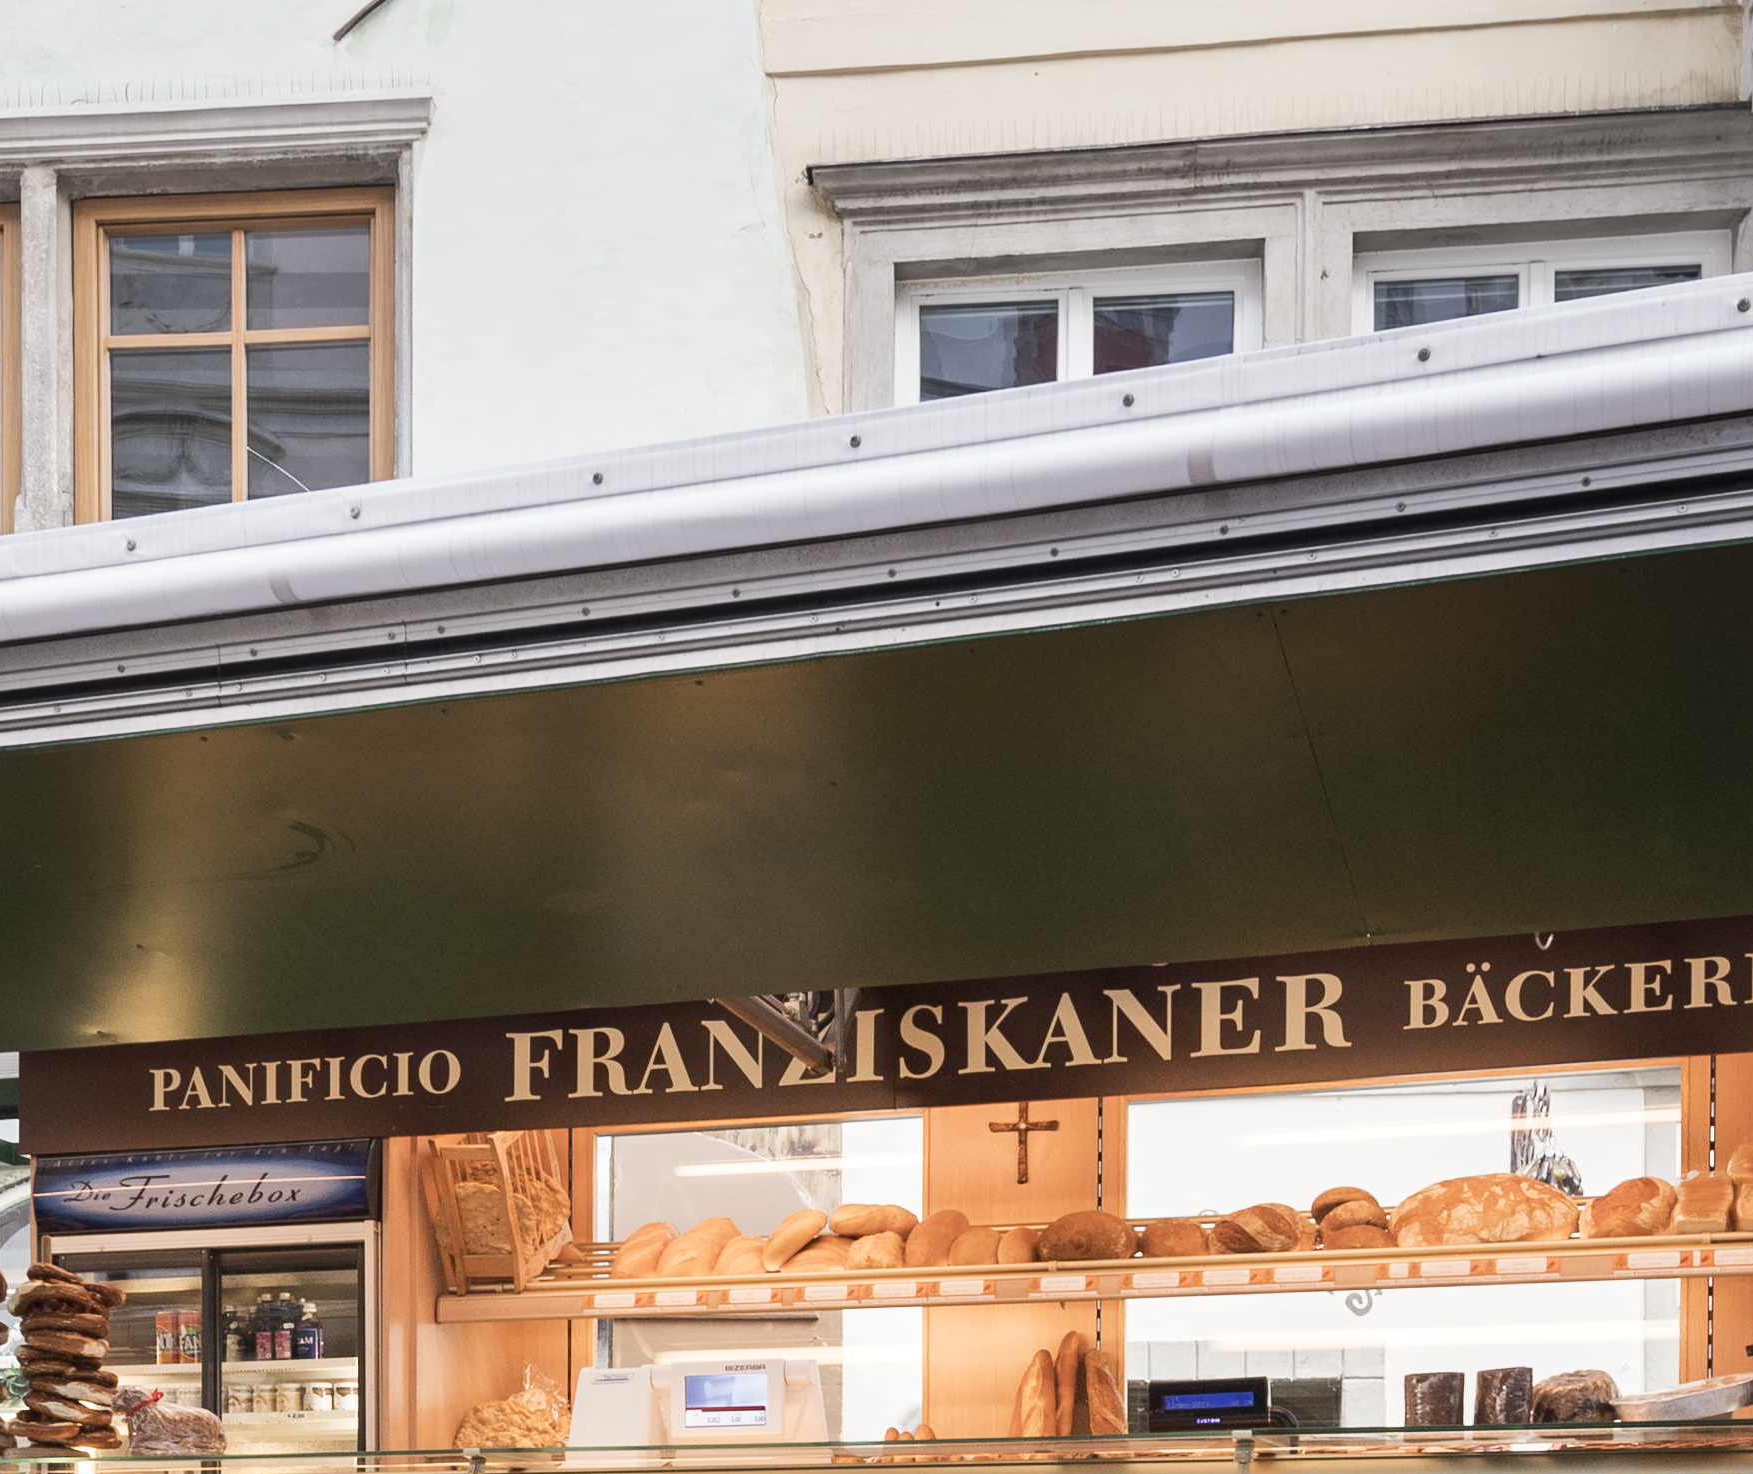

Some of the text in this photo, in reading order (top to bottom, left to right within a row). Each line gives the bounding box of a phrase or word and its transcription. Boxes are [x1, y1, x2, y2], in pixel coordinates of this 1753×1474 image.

[148, 1050, 462, 1112] PANIFICIO
[64, 1172, 302, 1212] Die Frischebox
[725, 1363, 766, 1371] BIZERBA
